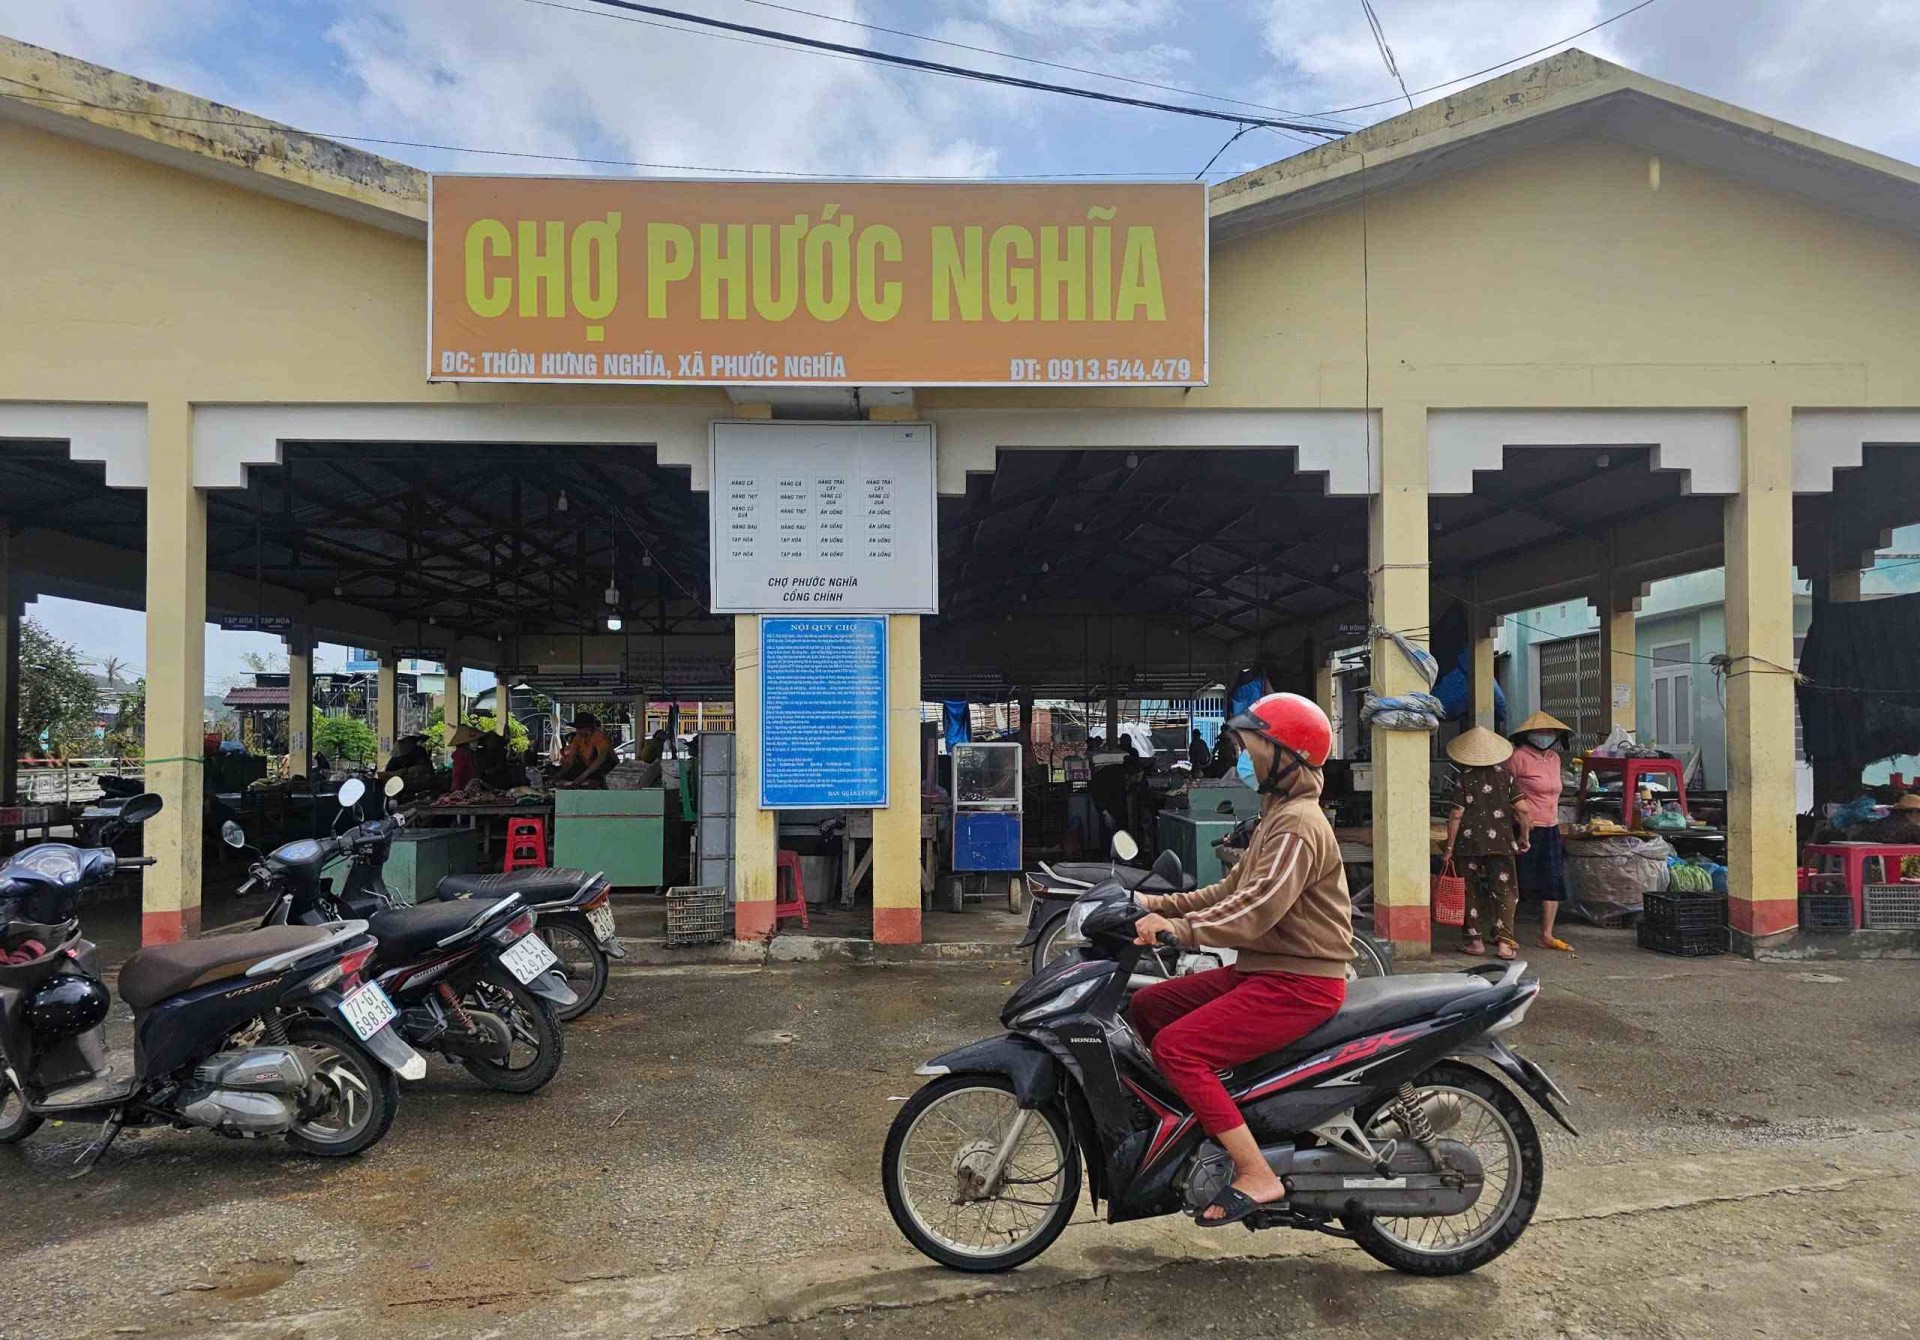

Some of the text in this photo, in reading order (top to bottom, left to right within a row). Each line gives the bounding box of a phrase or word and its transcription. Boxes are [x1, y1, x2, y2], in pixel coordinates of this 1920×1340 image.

[465, 204, 1167, 341] CHỢ PHƯỚC NGHĨA
[441, 348, 846, 379] ĐC: THÔN HƯNG NGHĨA, XÃ PHƯỚC NGHĨA
[1010, 358, 1192, 381] ĐT: 0913.544.479
[768, 575, 858, 588] CHỢ PHƯỚC NGHĨA
[783, 588, 843, 602] CỔNG CHÍNH
[791, 623, 858, 632] NỘI QUY CHỢ
[225, 977, 283, 999] VISION
[355, 1000, 393, 1036] 698.38
